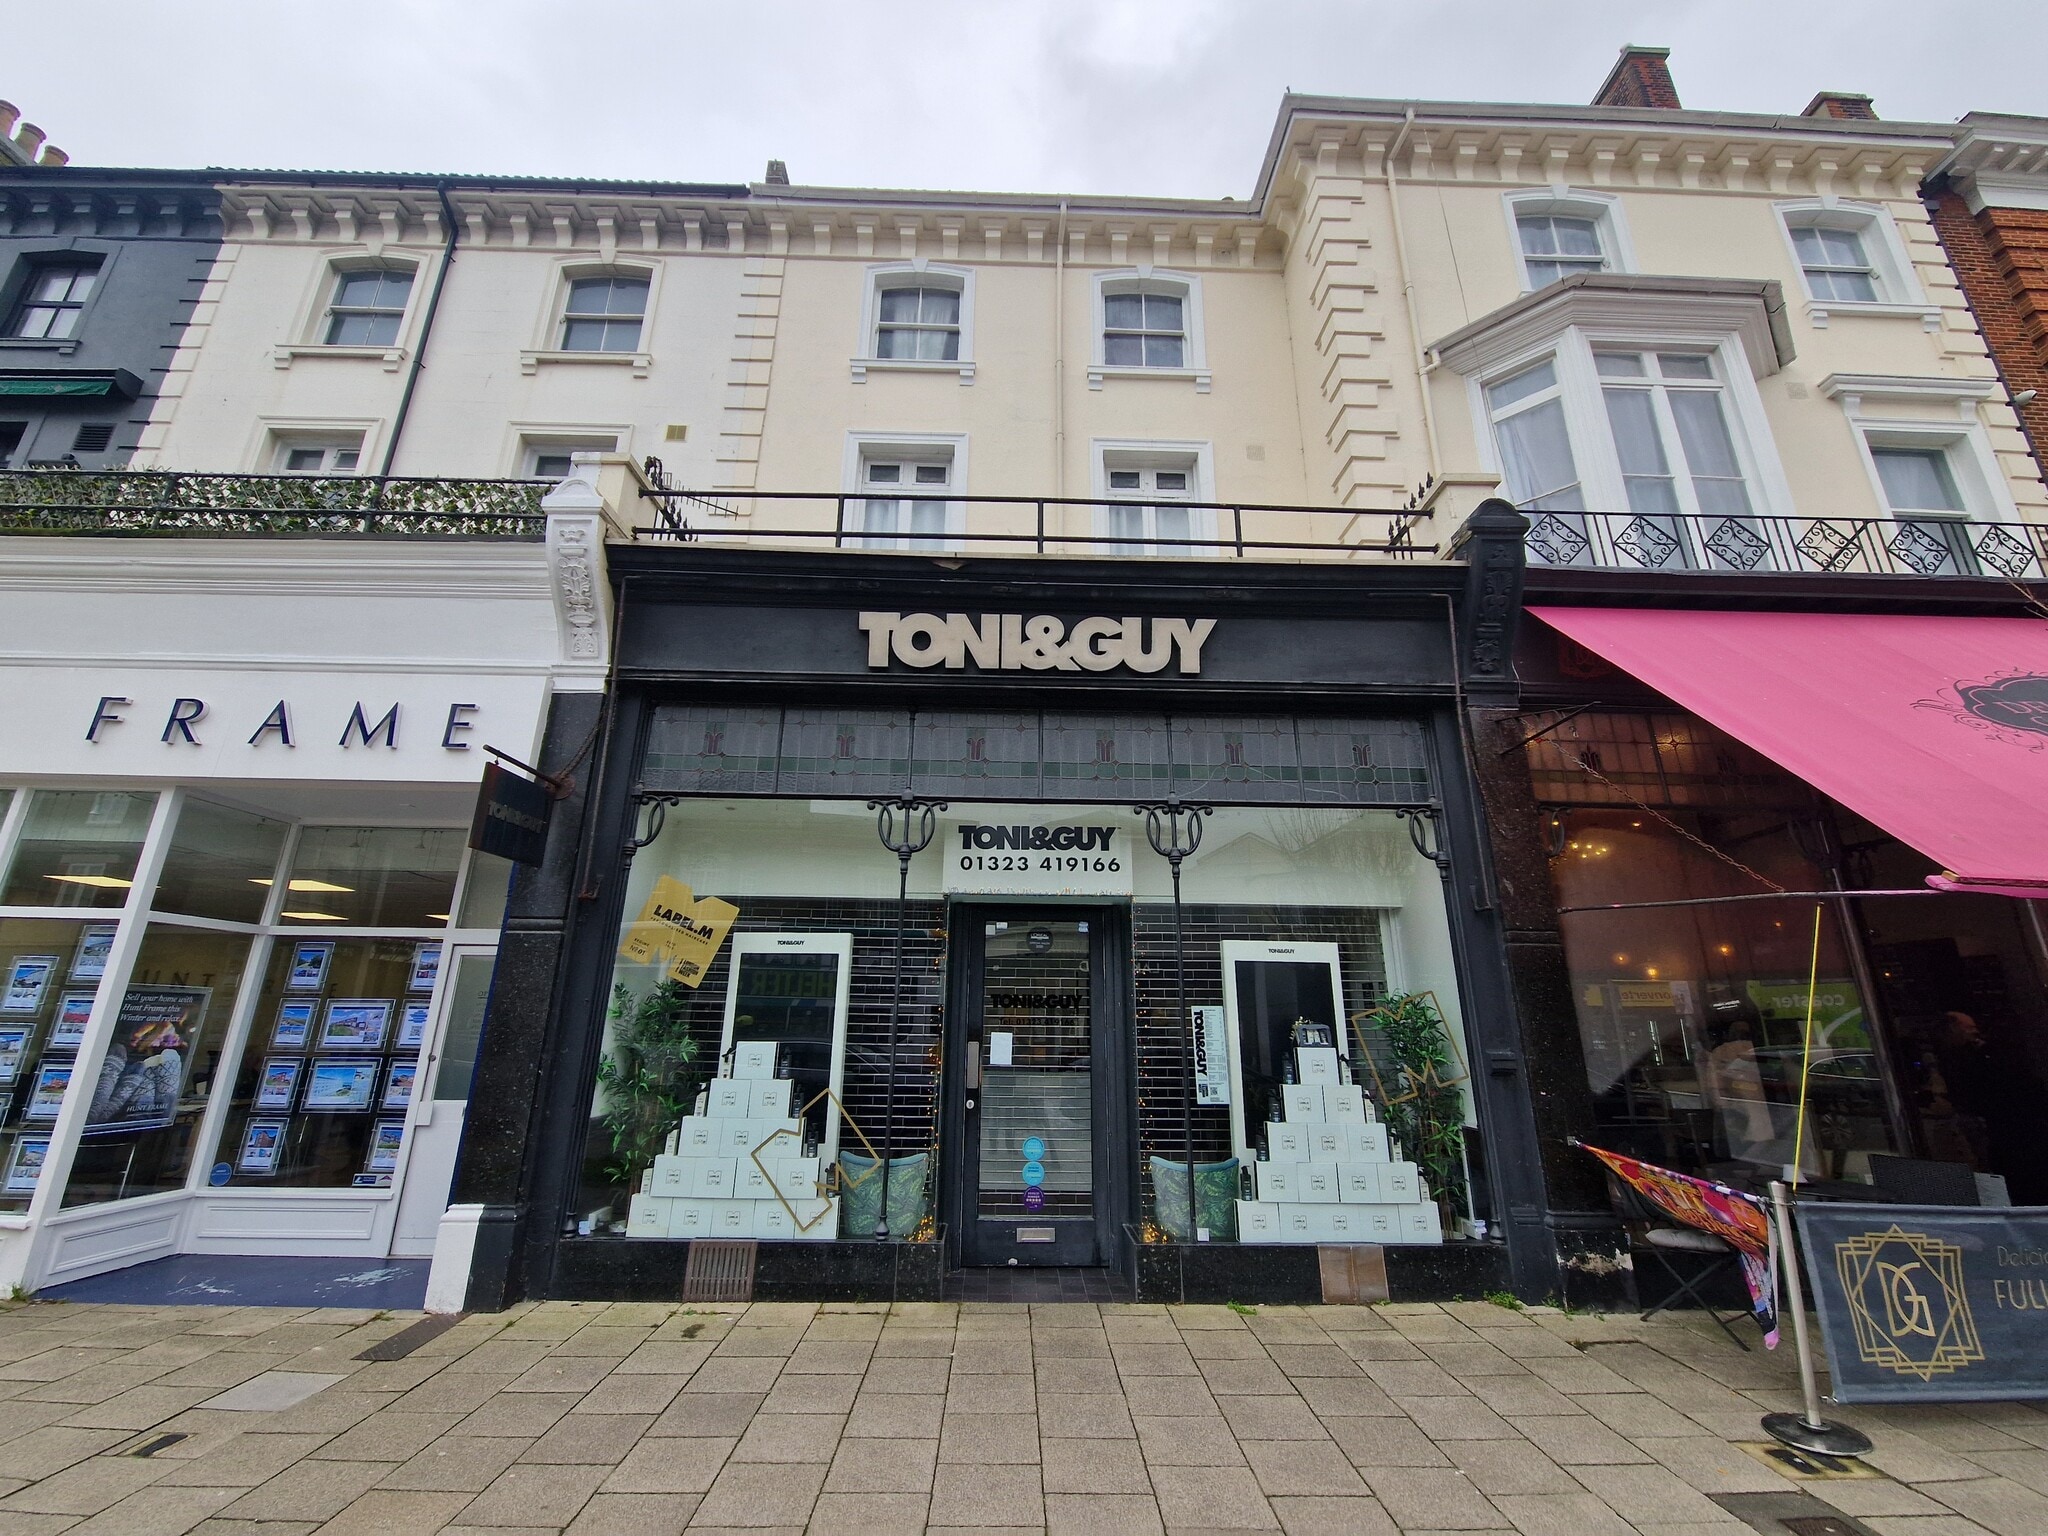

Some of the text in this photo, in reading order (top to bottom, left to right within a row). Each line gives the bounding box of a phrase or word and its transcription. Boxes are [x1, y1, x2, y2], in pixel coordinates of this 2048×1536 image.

[859, 611, 1218, 674] TONI&GUY
[85, 696, 480, 750] FRAME
[958, 825, 1117, 852] TONI&GUY
[960, 856, 1121, 872] 01323 419166
[653, 904, 715, 940] LABEL.M
[121, 1003, 181, 1012] Hunt Frame this
[125, 993, 194, 1003] Sell your home with
[990, 993, 1083, 1009] TONI&GUY
[119, 1013, 146, 1021] Winter
[146, 1013, 161, 1022] and
[1193, 1009, 1208, 1076] TONI&GUY
